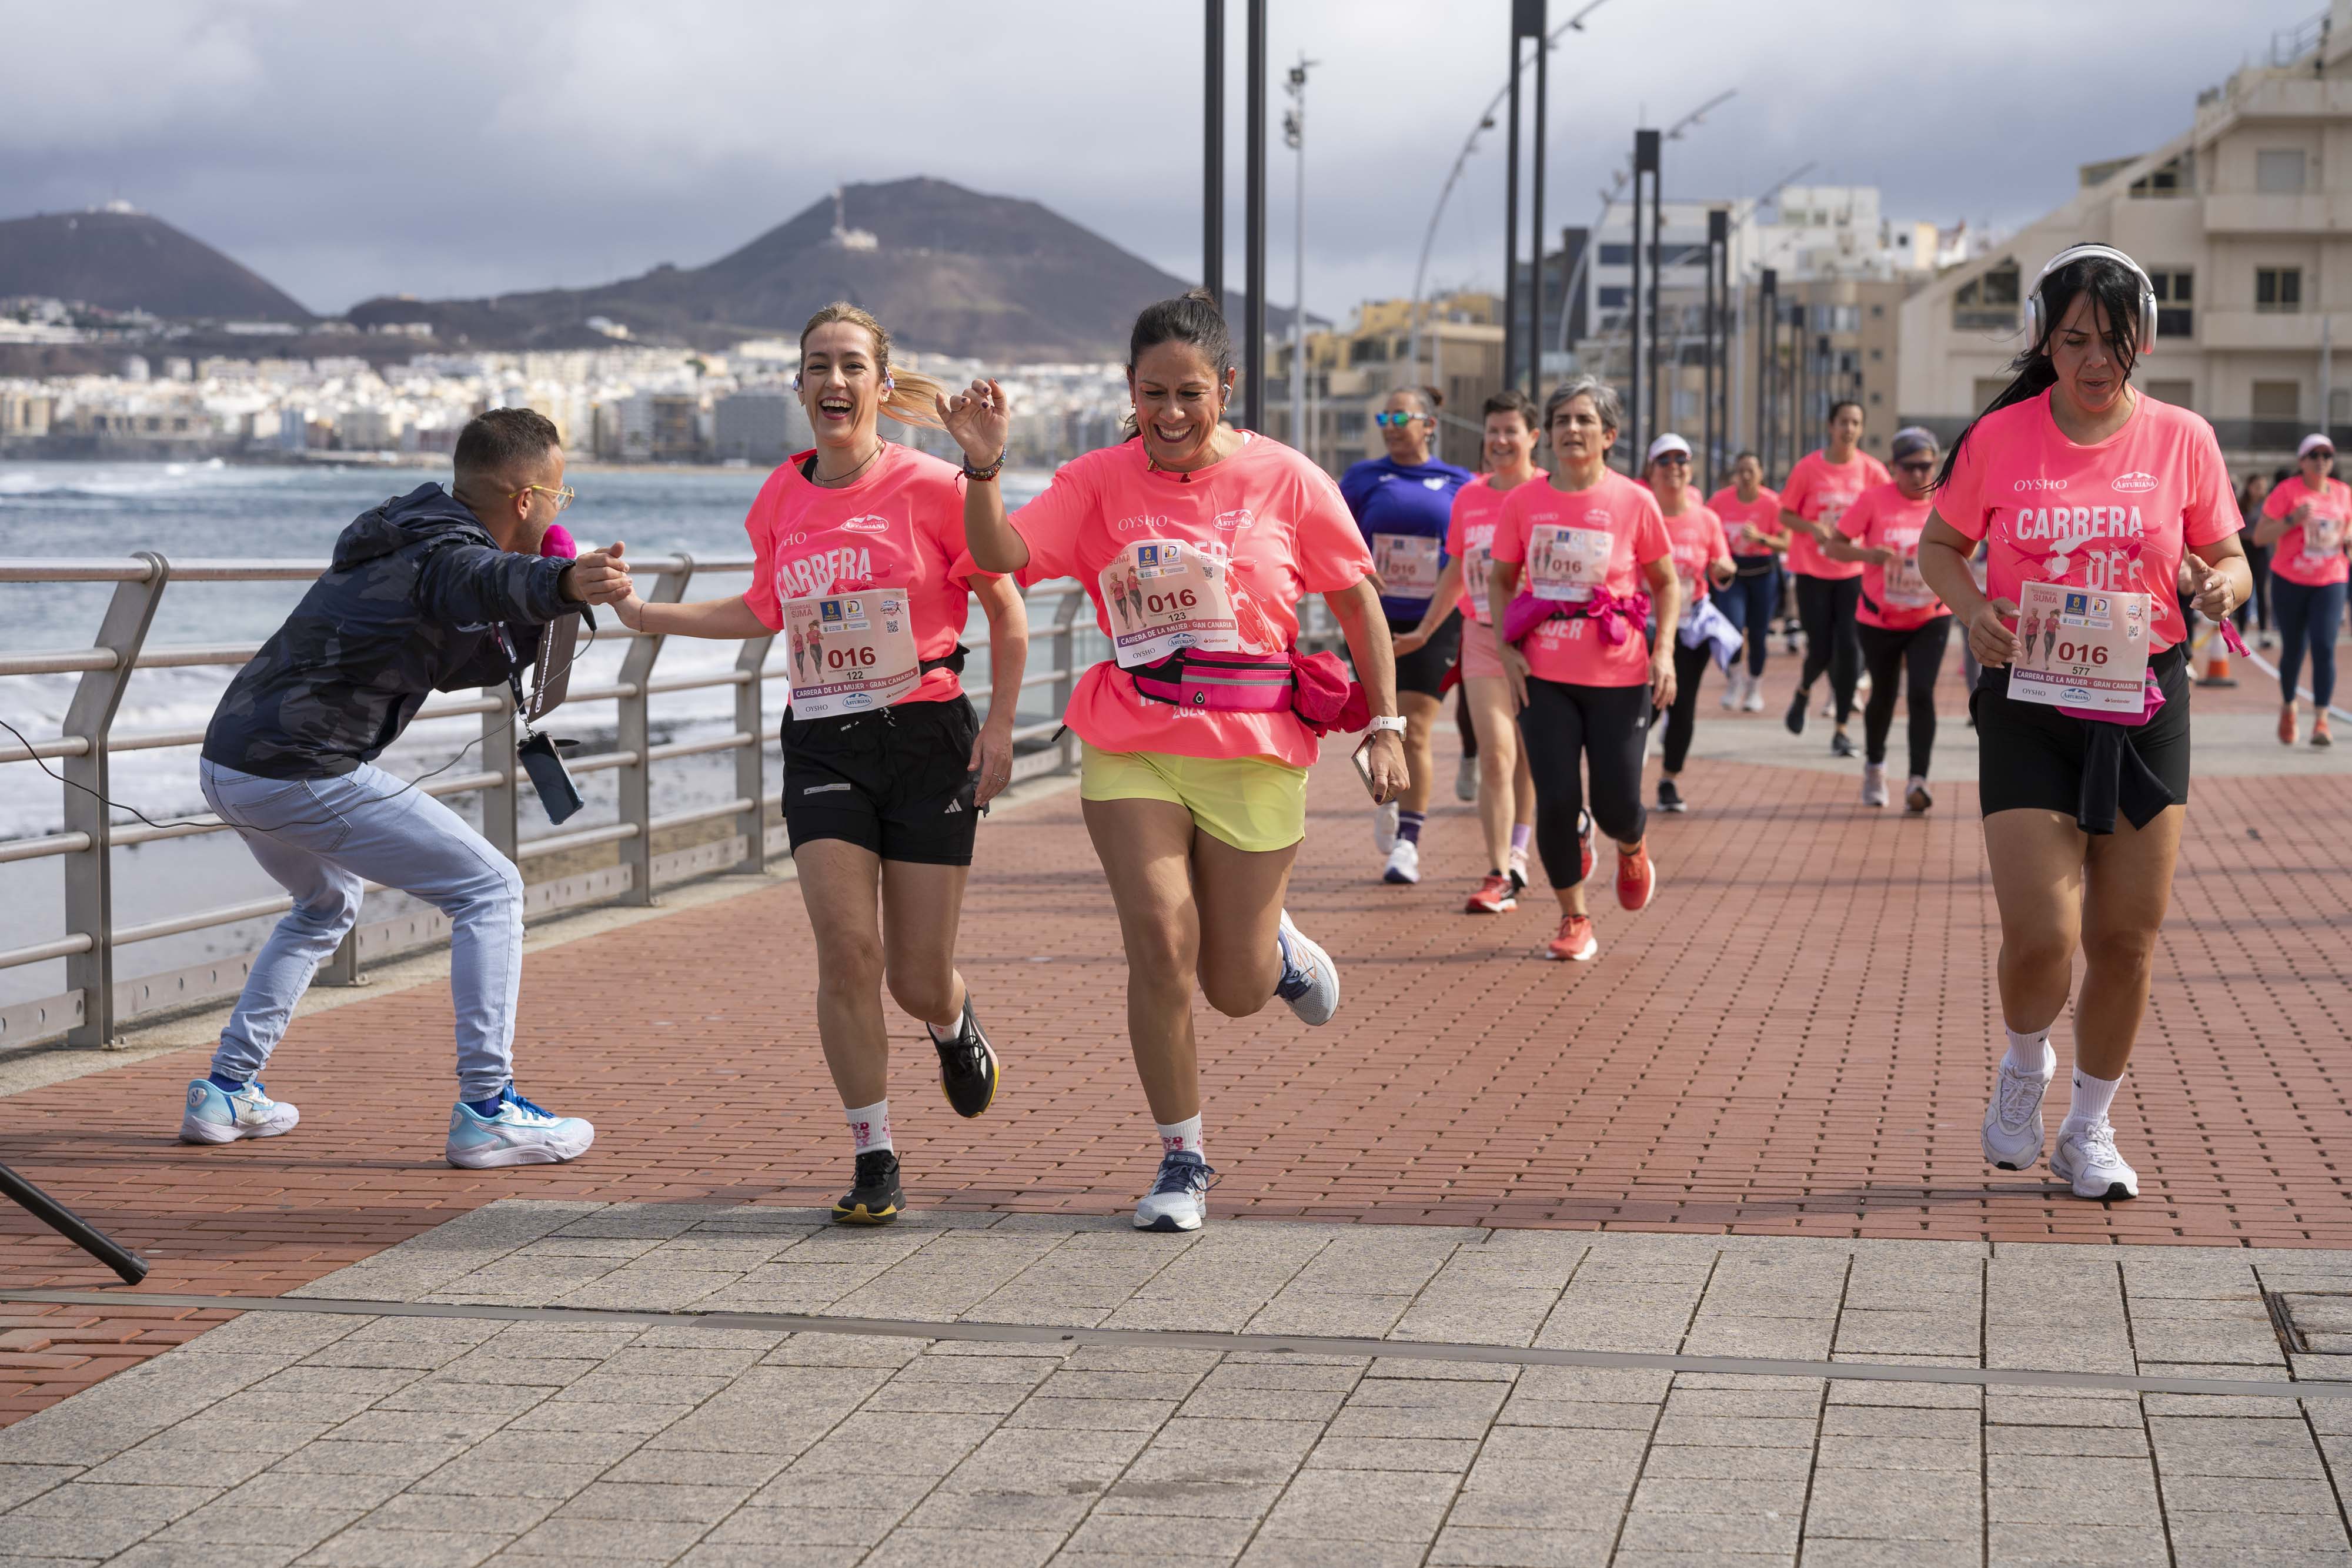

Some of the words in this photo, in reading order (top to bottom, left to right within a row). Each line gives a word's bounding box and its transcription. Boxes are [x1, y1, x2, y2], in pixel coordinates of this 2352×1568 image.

[2014, 479, 2067, 492] OYSHO
[2116, 480, 2155, 489] ASTURIANA
[1118, 515, 1168, 530] OYSHO
[2016, 506, 2144, 540] CARRERA
[1391, 564, 1416, 575] 016
[1552, 560, 1582, 573] 016
[776, 547, 873, 601] CARRERA
[1148, 589, 1197, 613] 016
[2033, 594, 2057, 604] SUMA
[791, 609, 813, 618] SUMA
[1168, 612, 1186, 622] 123
[1121, 633, 1147, 645] CARRERA
[1167, 624, 1188, 633] MUJER
[828, 647, 876, 668] 016
[1132, 648, 1155, 658] OYSHO
[2059, 642, 2108, 665] 016
[847, 671, 864, 680] 122
[2072, 666, 2090, 676] 577
[796, 688, 822, 697] CARRERA
[844, 683, 864, 691] MUJER
[888, 671, 914, 685] CANARIA
[2017, 670, 2044, 681] CARRERA
[2066, 678, 2088, 686] MUJER
[2022, 688, 2046, 697] OYSHO
